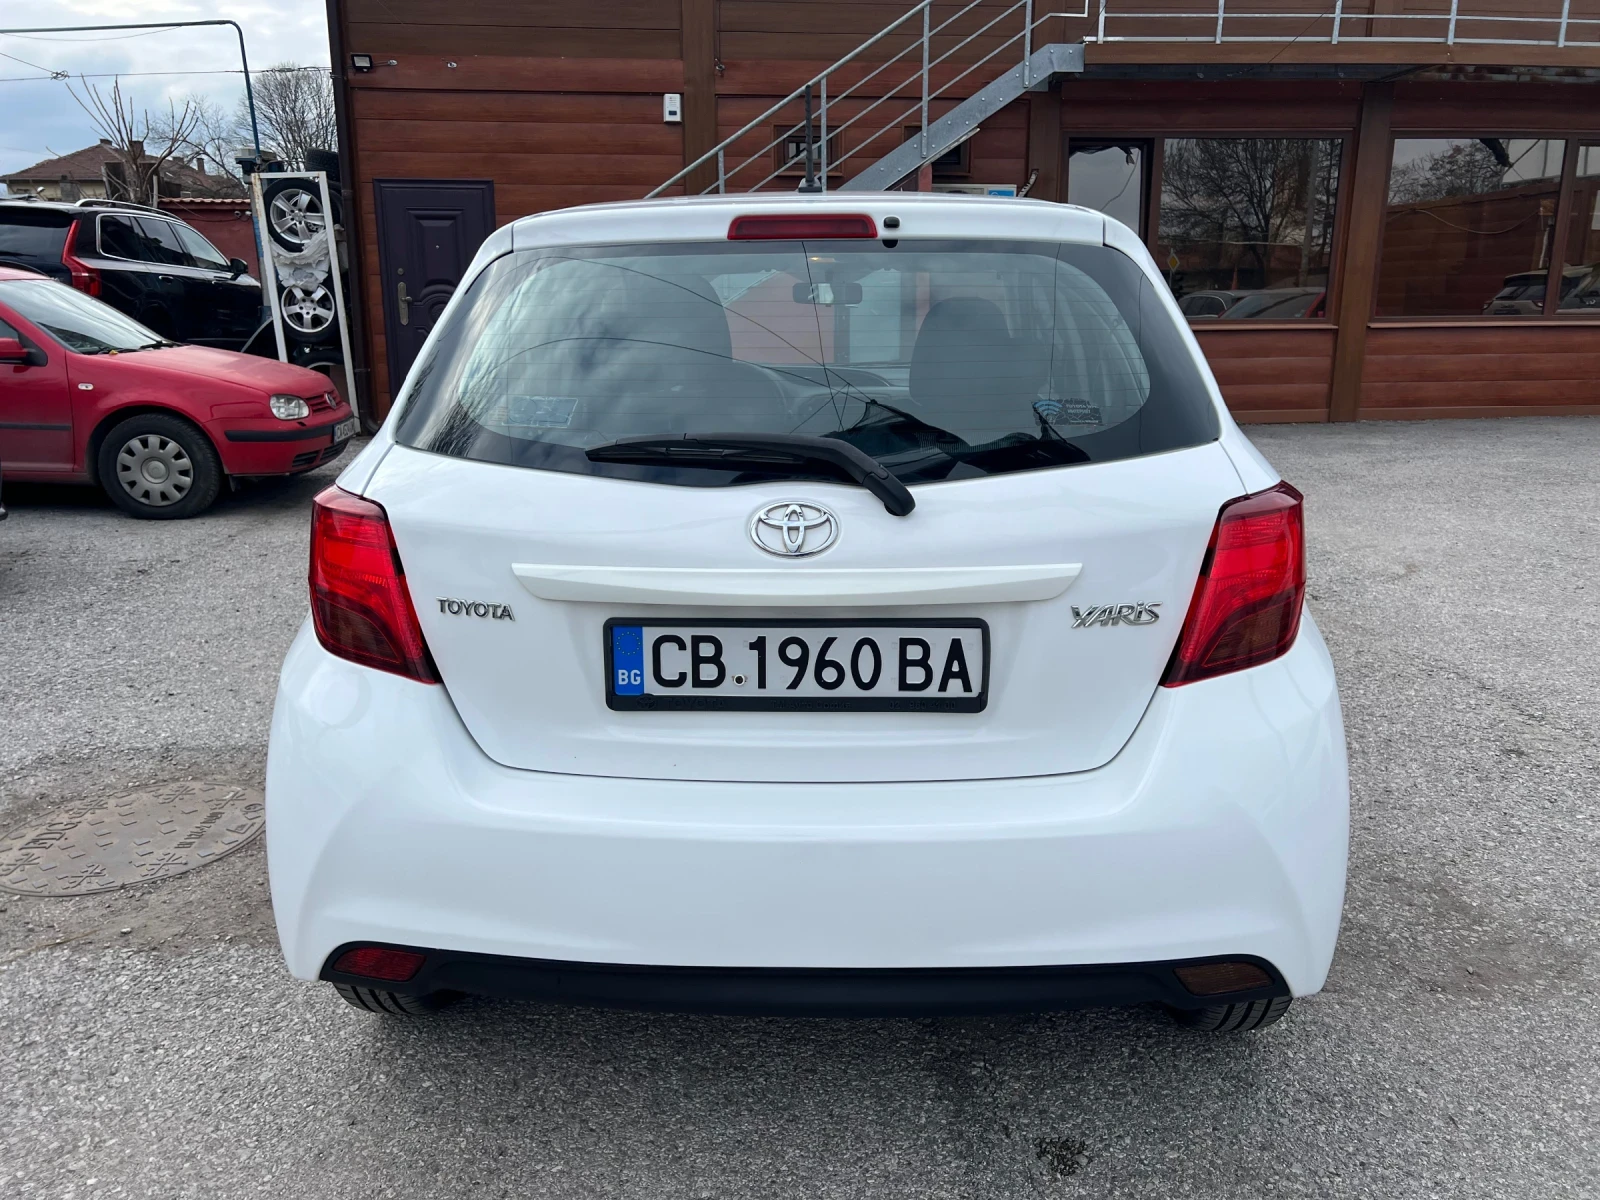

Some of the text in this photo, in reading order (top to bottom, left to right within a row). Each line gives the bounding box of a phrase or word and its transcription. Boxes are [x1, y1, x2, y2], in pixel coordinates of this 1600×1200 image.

[436, 596, 515, 621] TOYOTA
[652, 634, 973, 693] CB 1960 BA
[618, 669, 642, 685] BG
